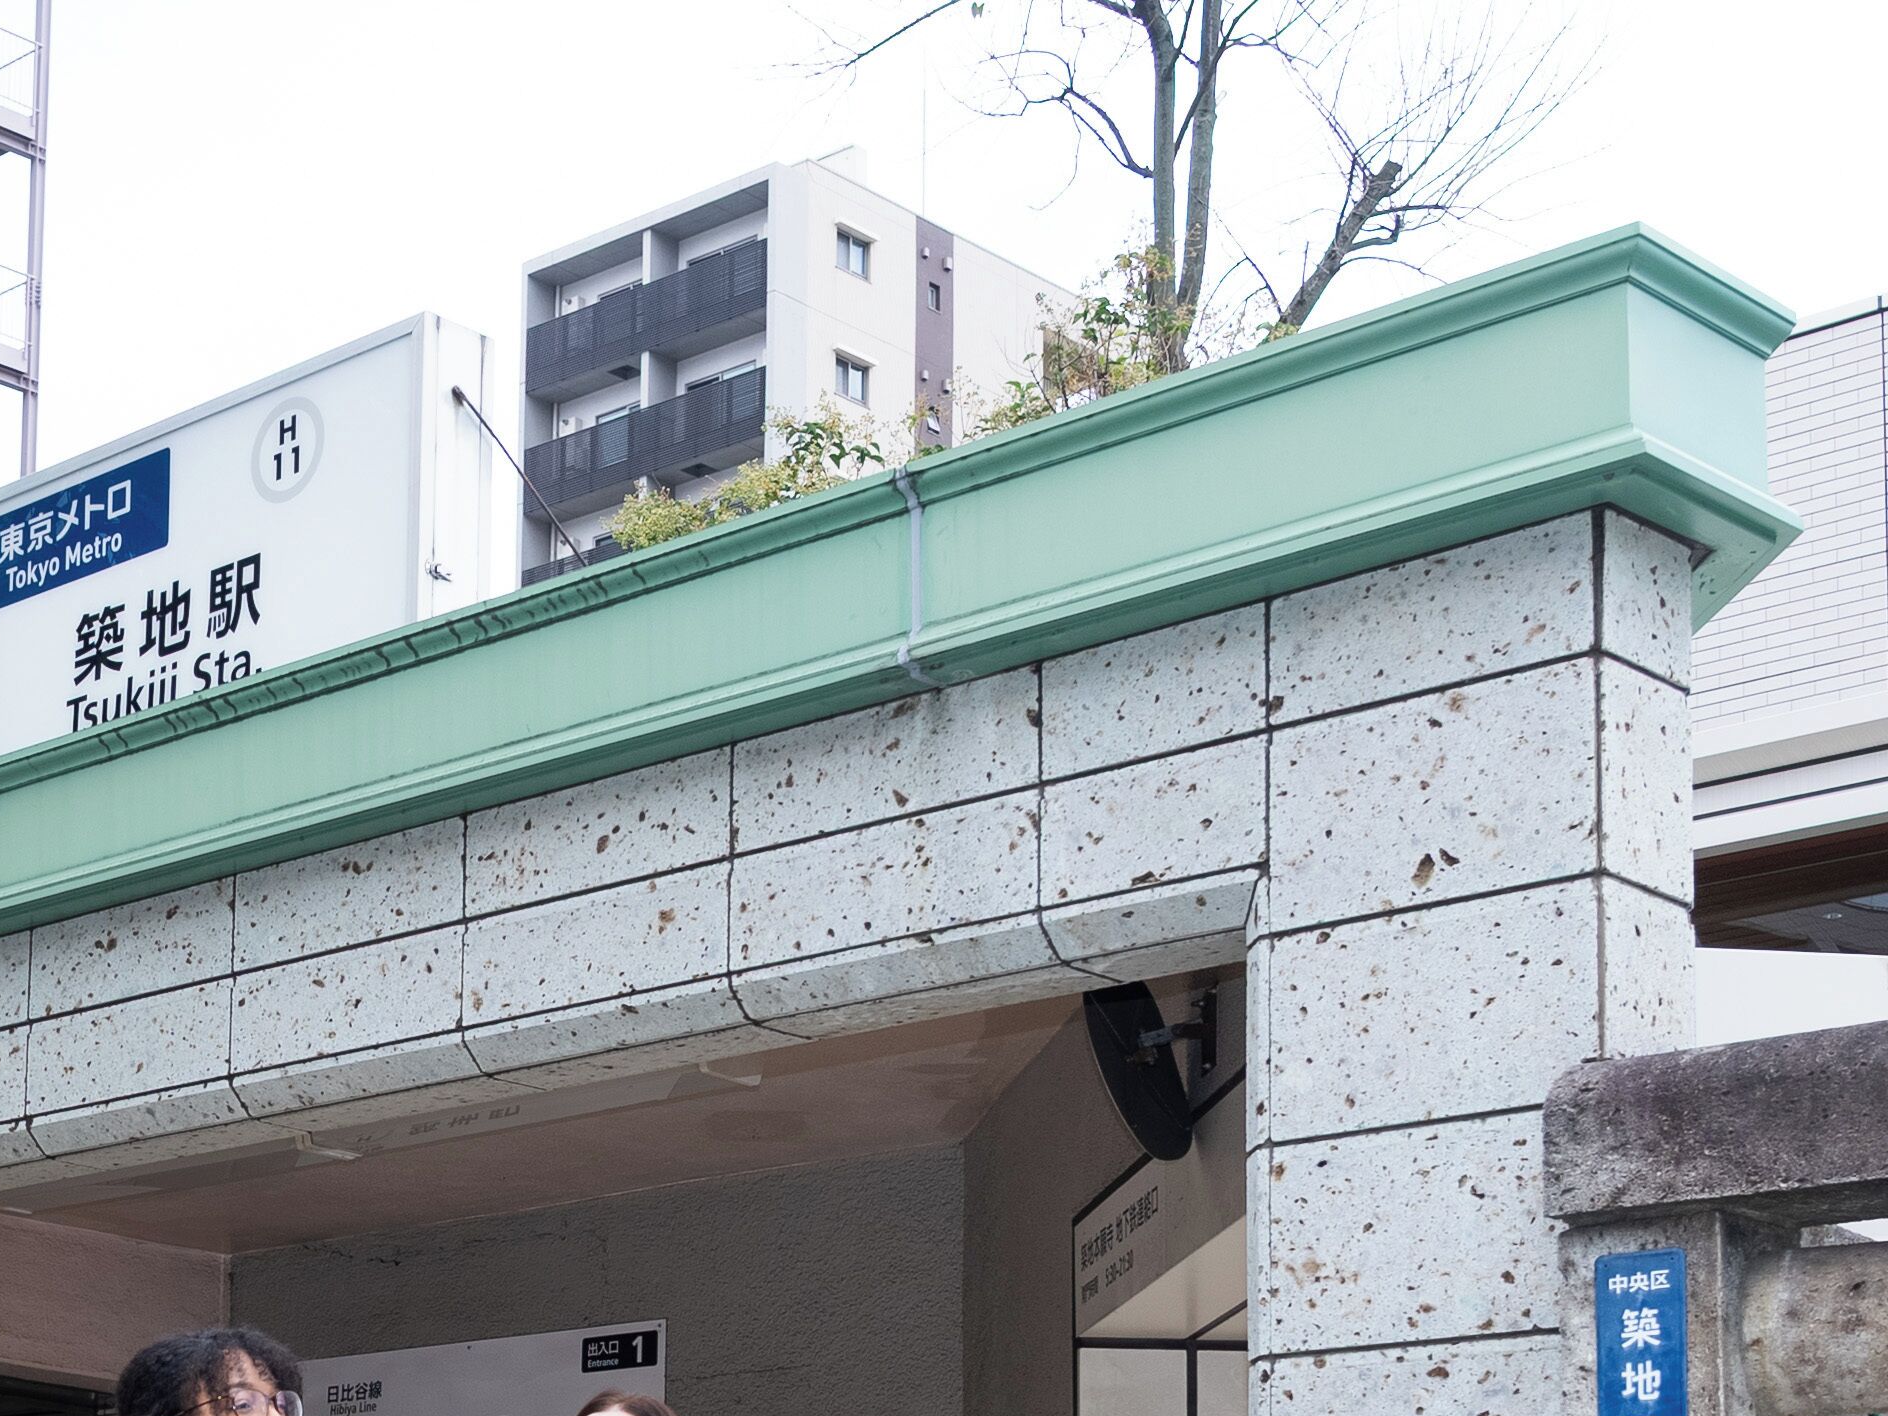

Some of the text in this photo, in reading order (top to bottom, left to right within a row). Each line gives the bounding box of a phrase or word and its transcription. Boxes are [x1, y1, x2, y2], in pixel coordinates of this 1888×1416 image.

[279, 415, 297, 446] H
[273, 446, 301, 481] 11
[0, 480, 131, 564] 東京メトロ
[6, 533, 122, 592] Tokyo Metro
[73, 553, 261, 687] 築地駅
[1608, 1269, 1671, 1294] 中央区
[587, 1358, 619, 1368] Entrance
[588, 1335, 643, 1363] 出入口 1
[327, 1380, 383, 1403] 日比谷線
[330, 1401, 377, 1416] Hibiya Line
